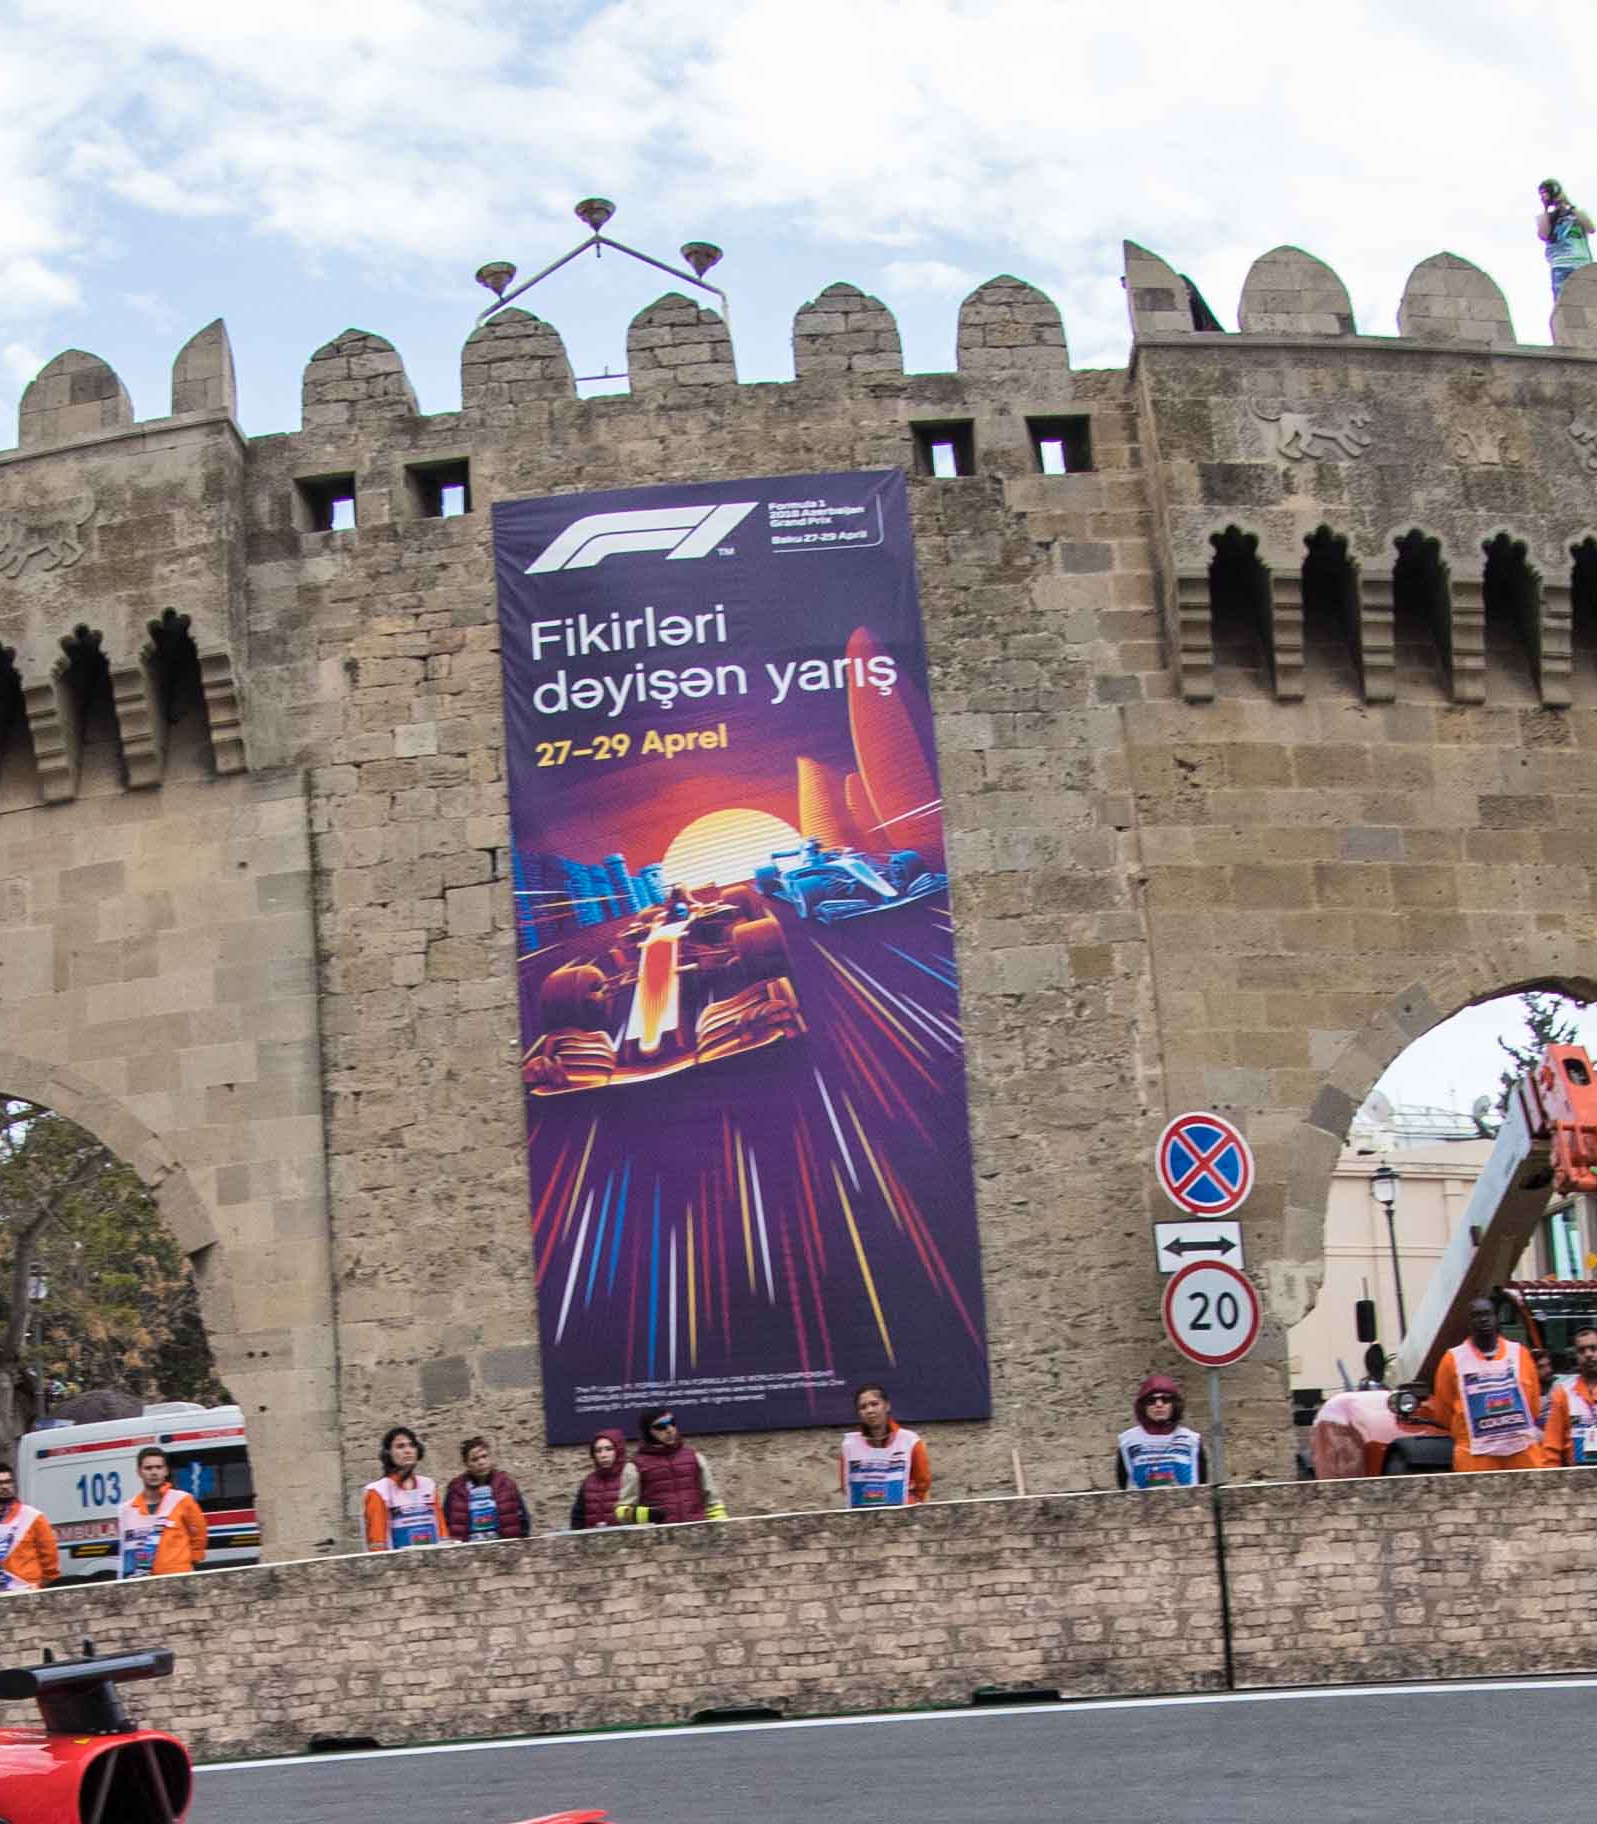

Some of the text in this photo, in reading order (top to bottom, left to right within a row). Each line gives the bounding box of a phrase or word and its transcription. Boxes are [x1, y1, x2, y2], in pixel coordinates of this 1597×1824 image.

[530, 604, 727, 660] Fikirləri
[533, 654, 899, 718] dəyişən yarış
[641, 723, 729, 760] Aprel
[1188, 1291, 1239, 1331] 20
[76, 1472, 122, 1508] 103
